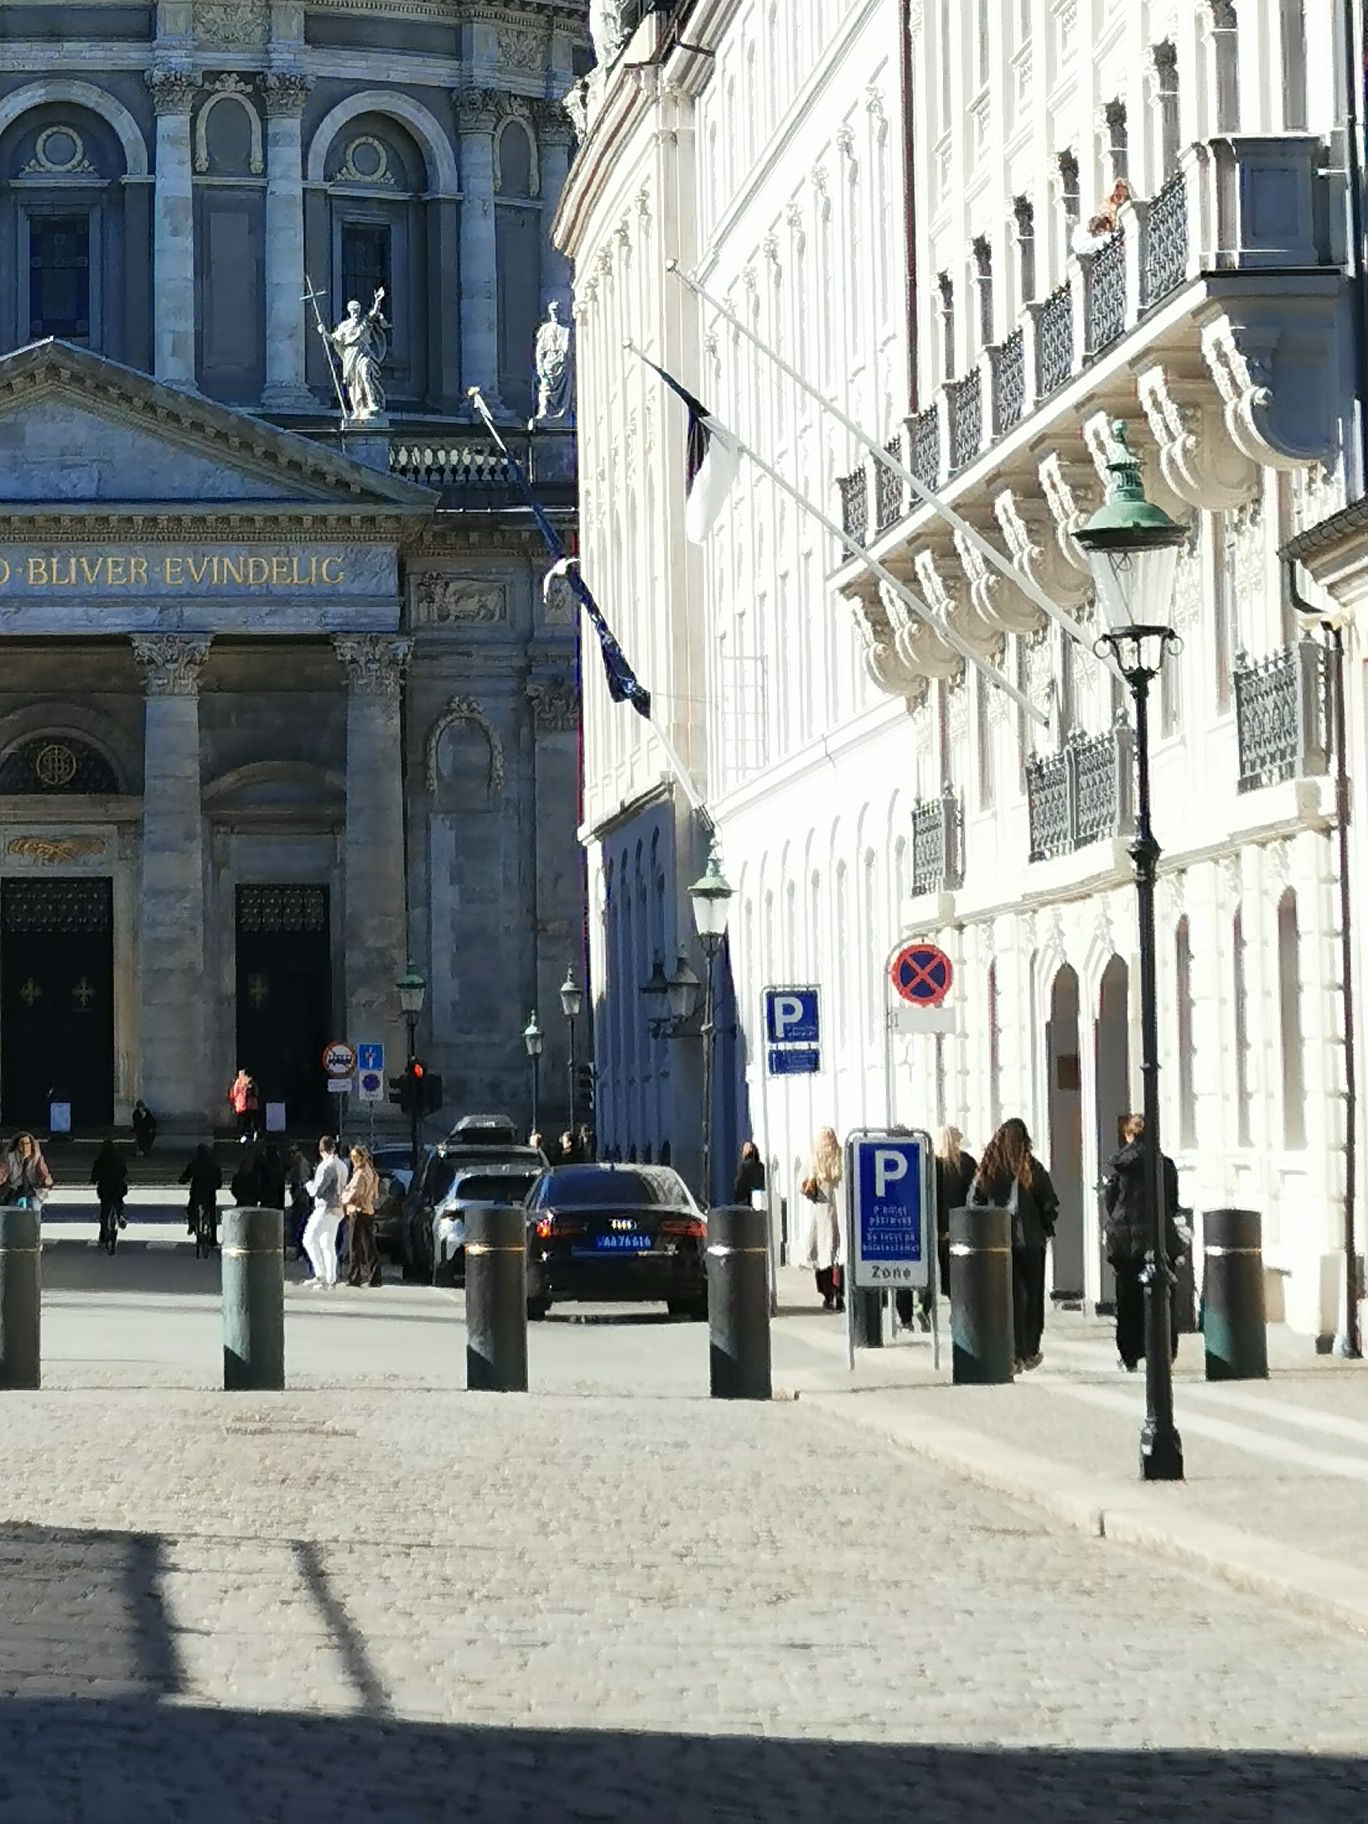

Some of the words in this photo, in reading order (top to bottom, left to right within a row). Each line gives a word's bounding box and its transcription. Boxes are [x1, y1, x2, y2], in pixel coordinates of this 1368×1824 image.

[27, 556, 149, 586] BLIVER
[164, 555, 346, 586] EVINDELIG
[774, 996, 804, 1038] P
[874, 1149, 908, 1197] P
[871, 1264, 912, 1281] Zone
